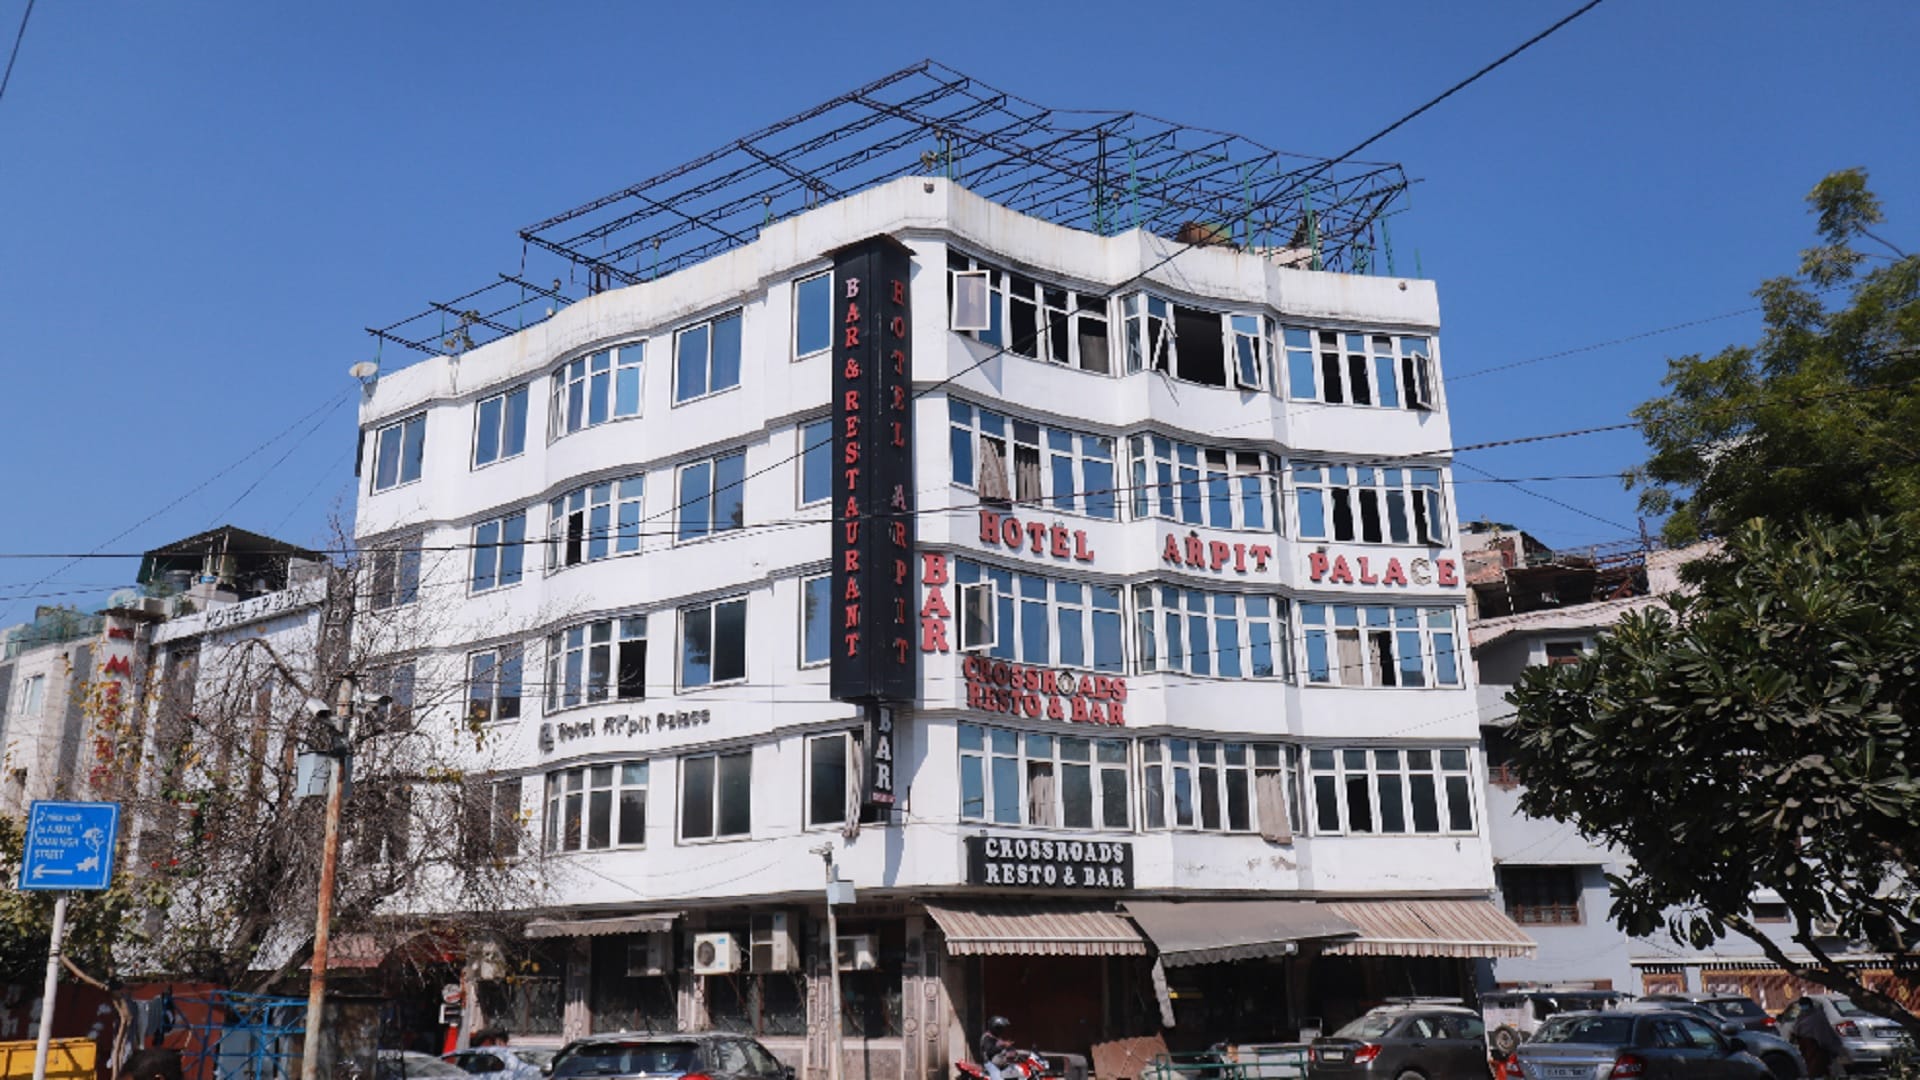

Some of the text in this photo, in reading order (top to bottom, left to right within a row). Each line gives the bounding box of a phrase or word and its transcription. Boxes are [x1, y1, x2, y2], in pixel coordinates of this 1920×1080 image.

[844, 278, 861, 656] BAR & RESTAURANT
[890, 279, 908, 664] HOTEL ARPIT
[979, 509, 1459, 587] HOTEL ARPIT PALACE
[920, 553, 951, 652] BAR
[964, 656, 1127, 701] CROSSROADS
[967, 682, 1126, 725] RESTO & BAR
[874, 706, 892, 790] BAR
[985, 838, 1125, 864] CROSSROADS
[985, 863, 1126, 888] RESTO & BAR
